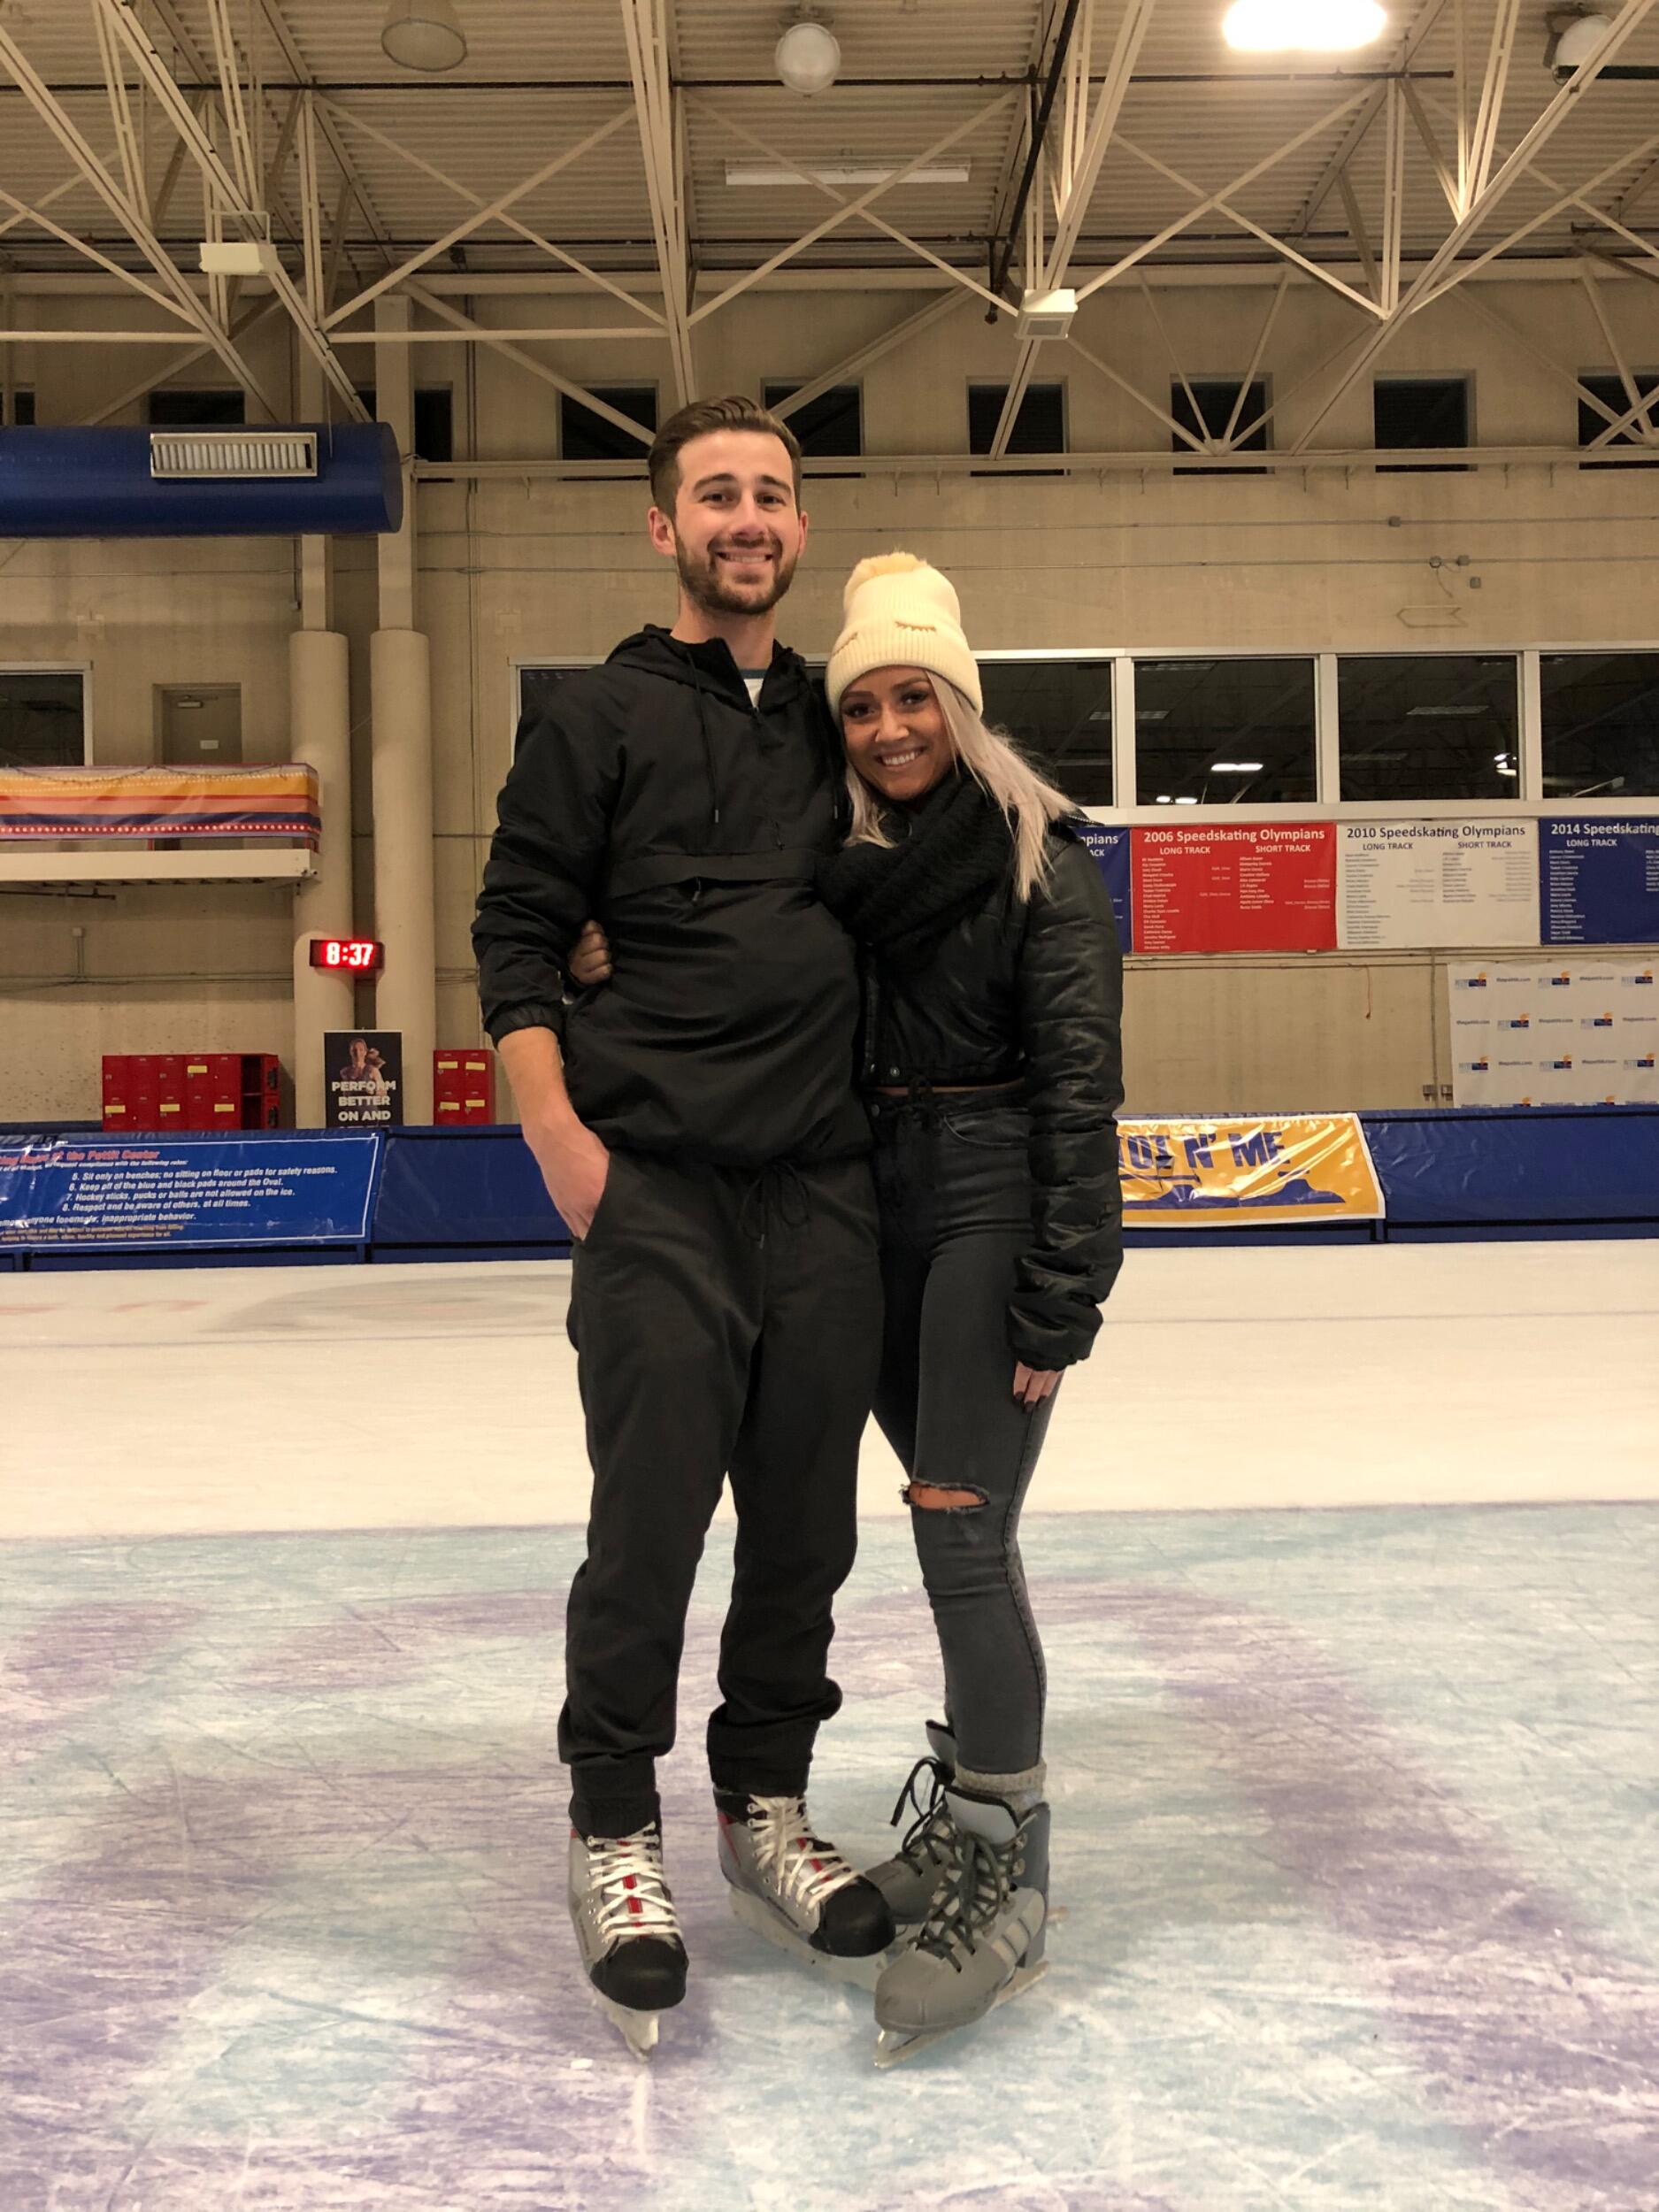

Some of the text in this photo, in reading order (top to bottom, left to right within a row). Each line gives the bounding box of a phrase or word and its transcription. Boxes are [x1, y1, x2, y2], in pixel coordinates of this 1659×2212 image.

[1347, 824, 1525, 840] 2010 Speedskating Olympians
[1551, 824, 1579, 834] 2014
[1080, 833, 1118, 847] pians
[1144, 828, 1325, 843] 2006 Speedskating Olympians
[1186, 845, 1210, 855] TRACK
[326, 942, 373, 965] 8:37
[332, 1080, 396, 1092] PERFORM
[338, 1096, 390, 1107] BETTER
[338, 1110, 391, 1121] ON AND
